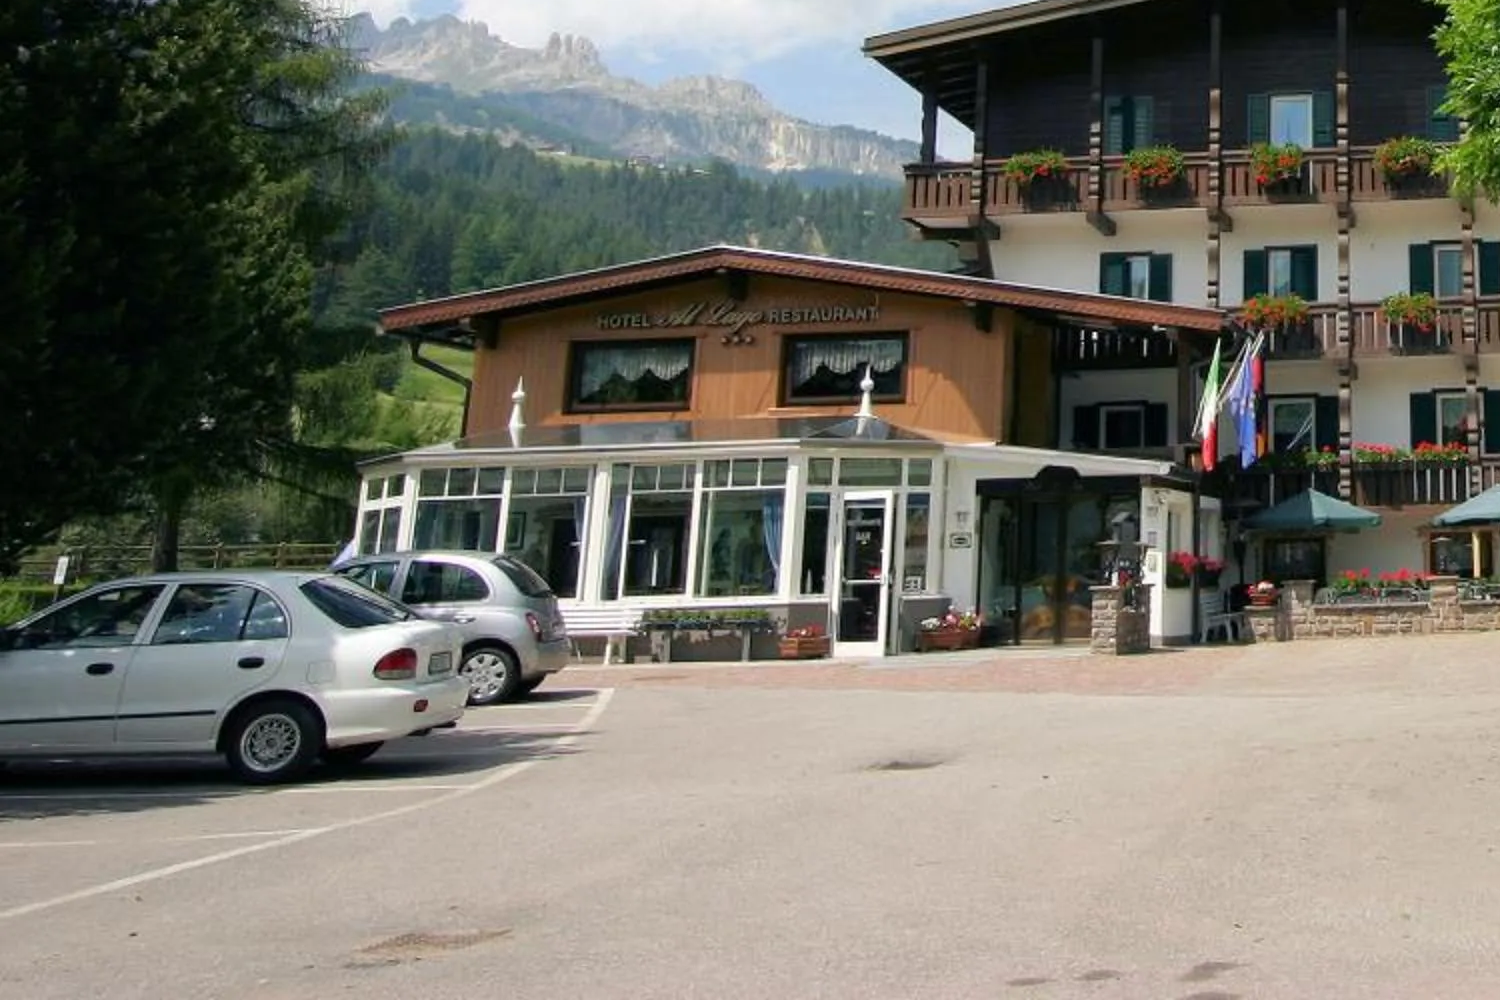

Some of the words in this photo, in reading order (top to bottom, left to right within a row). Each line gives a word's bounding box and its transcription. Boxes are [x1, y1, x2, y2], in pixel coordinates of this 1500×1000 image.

[598, 313, 650, 328] HOTEL
[703, 300, 763, 334] Lago
[768, 306, 878, 323] RESTAURANT
